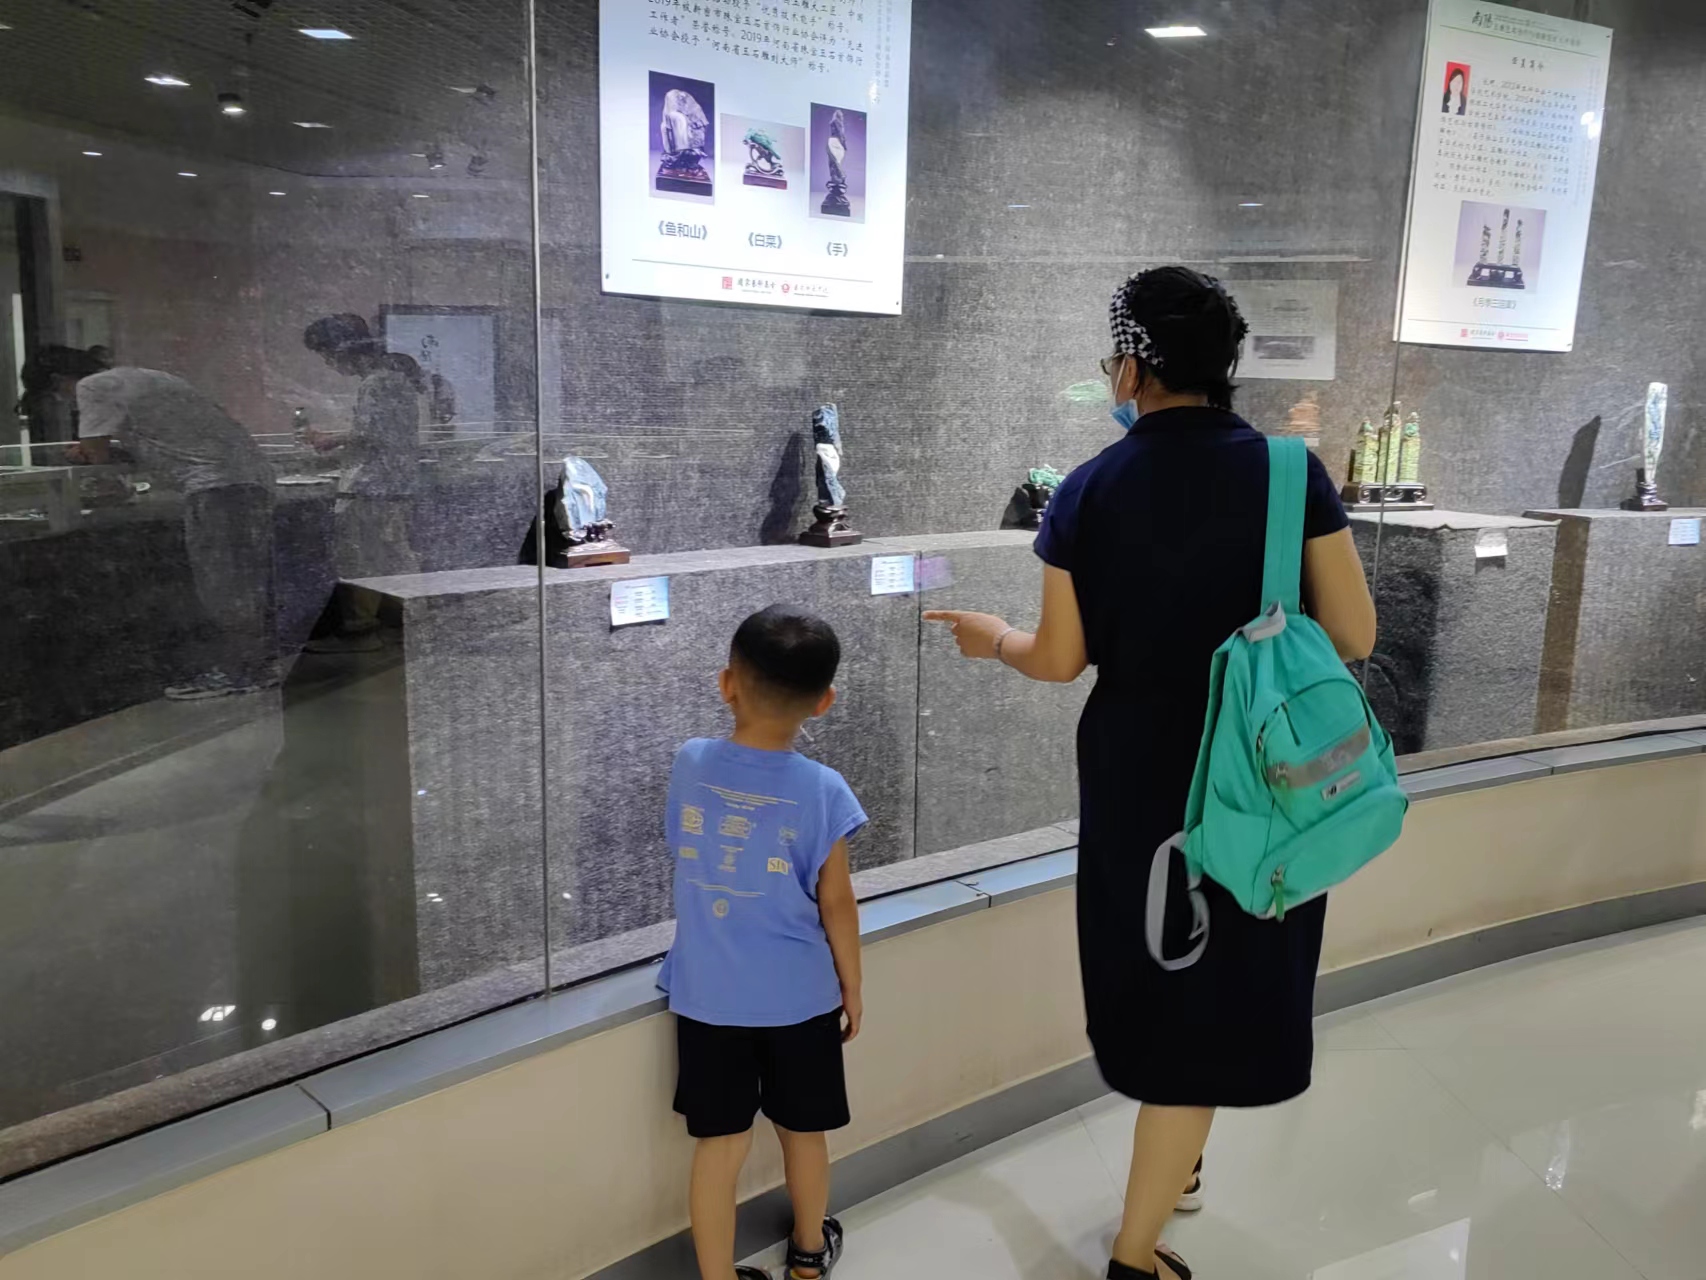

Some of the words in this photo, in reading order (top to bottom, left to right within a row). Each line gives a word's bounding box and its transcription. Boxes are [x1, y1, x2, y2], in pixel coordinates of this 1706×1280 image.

[658, 220, 708, 240] 《鱼和山》
[748, 232, 782, 249] 《白菜》
[826, 242, 849, 257] 《手》
